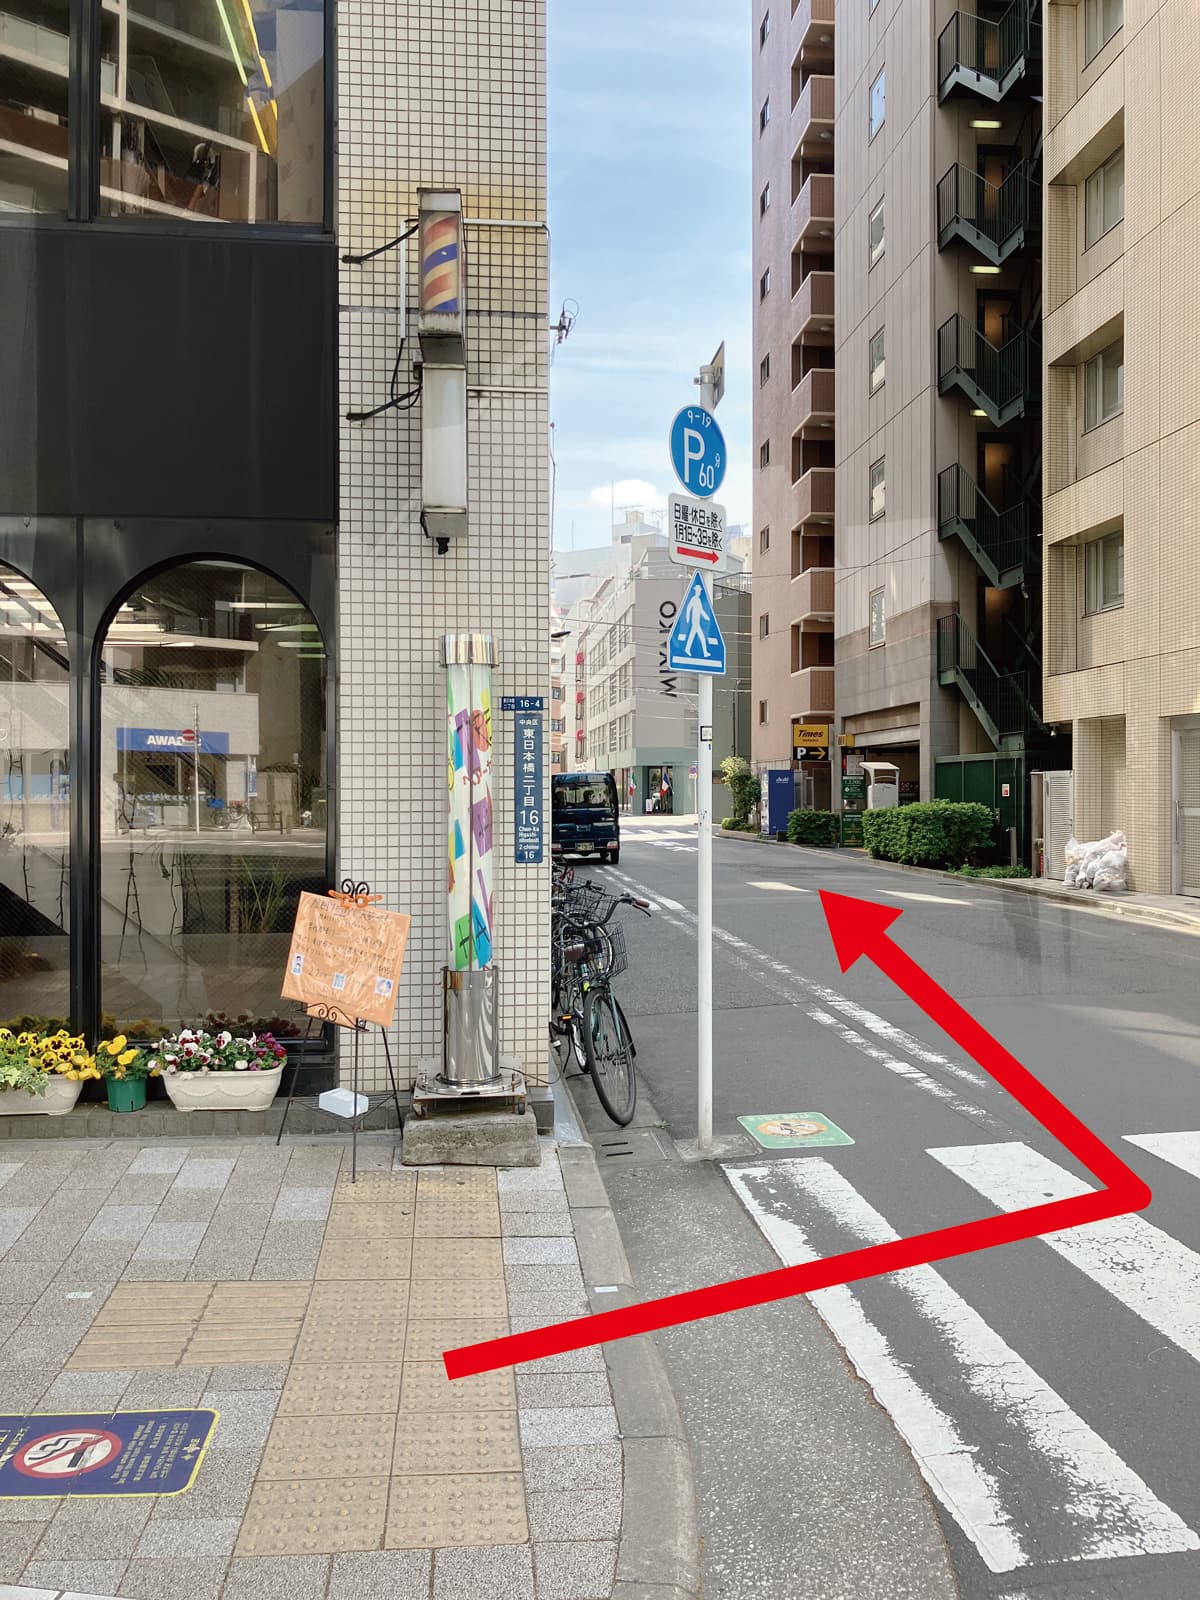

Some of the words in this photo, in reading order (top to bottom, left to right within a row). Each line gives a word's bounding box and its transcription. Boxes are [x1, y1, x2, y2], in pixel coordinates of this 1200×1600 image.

[687, 410, 712, 428] 9-19
[683, 427, 706, 483] P
[520, 699, 540, 708] 16-4
[798, 729, 824, 738] Times
[796, 747, 806, 759] P
[519, 809, 539, 825] 16
[524, 850, 535, 860] 16
